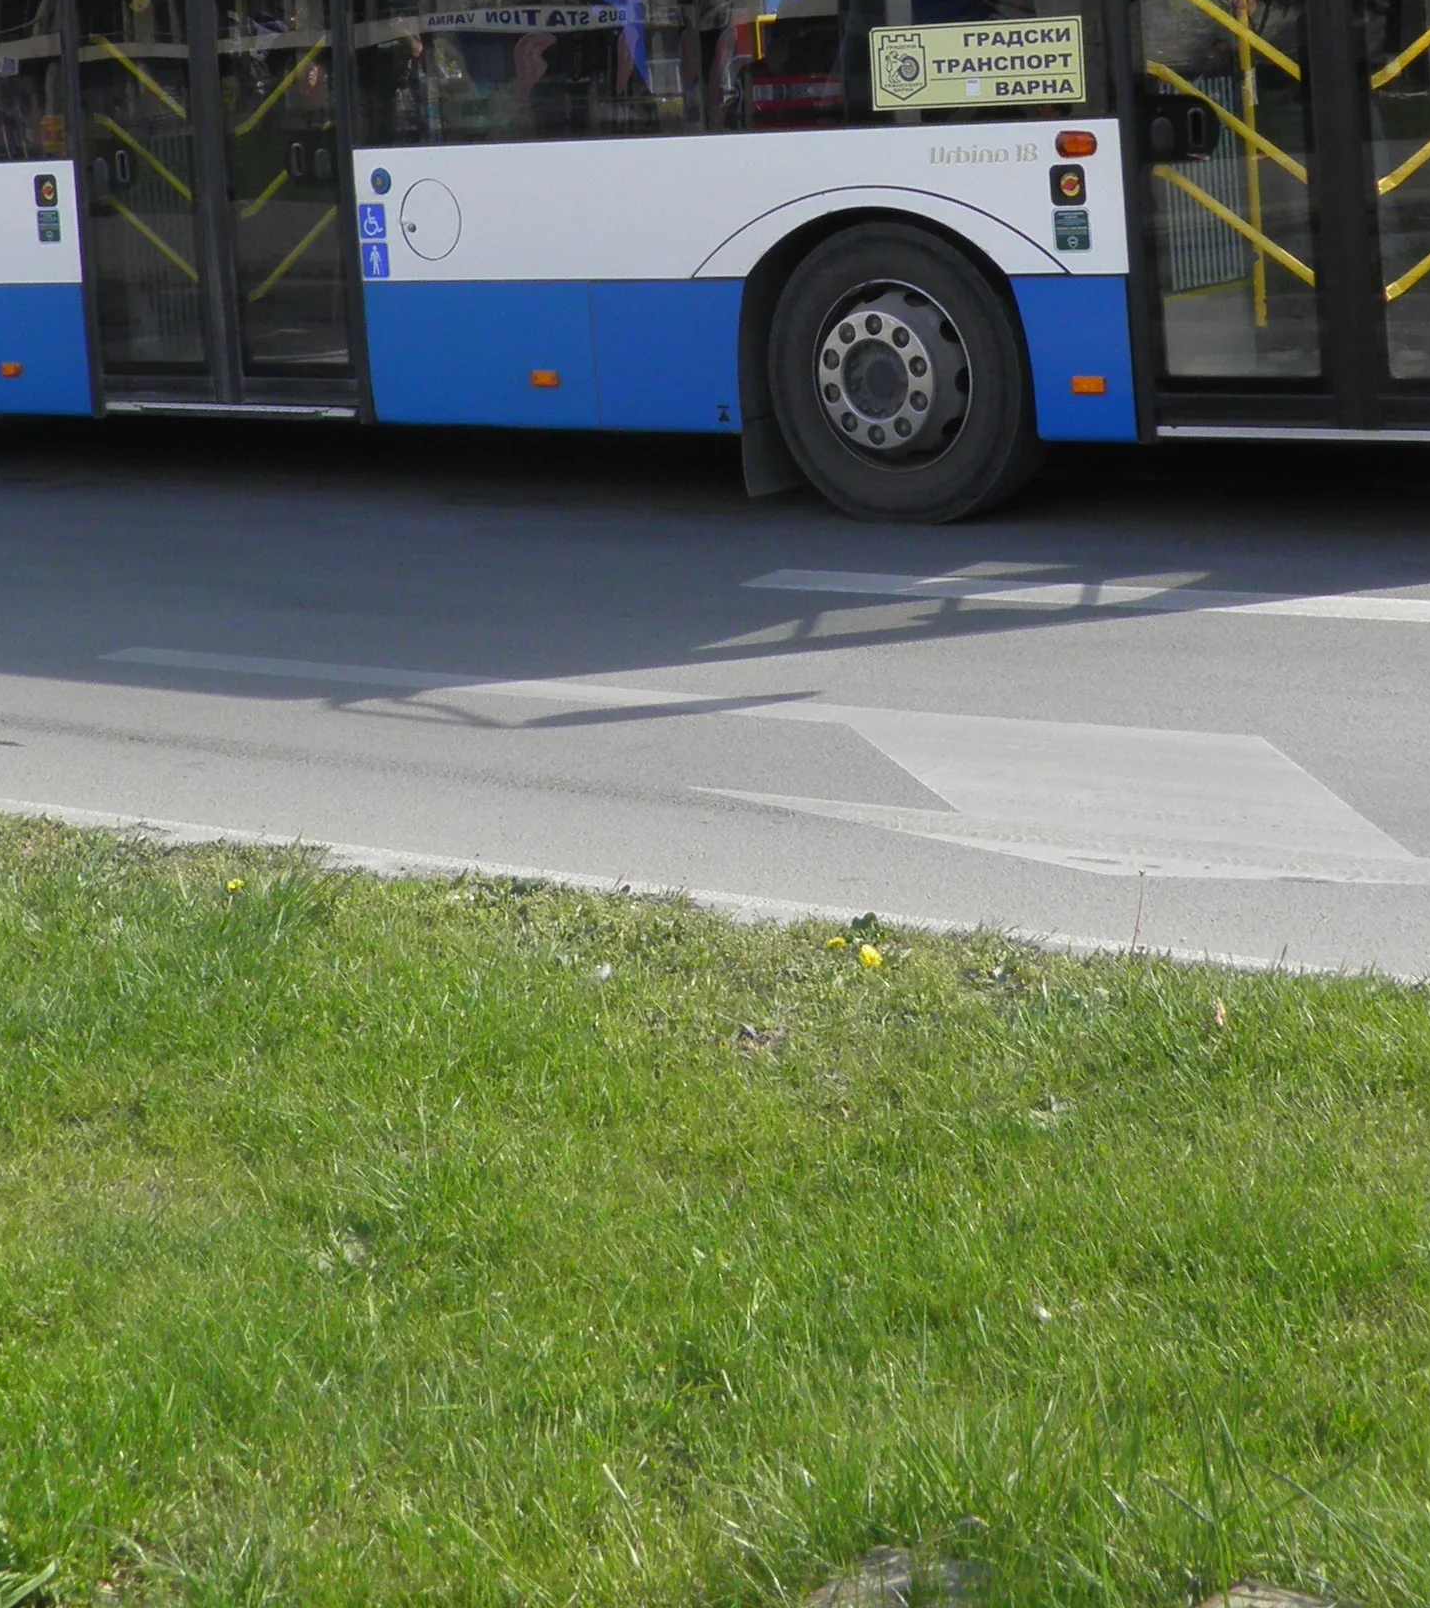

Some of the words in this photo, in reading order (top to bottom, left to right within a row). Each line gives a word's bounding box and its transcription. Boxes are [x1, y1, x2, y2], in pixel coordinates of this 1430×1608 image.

[963, 27, 1071, 48] ГРАДСКИ
[932, 53, 1072, 74] ТРАНСПОРТ
[995, 79, 1074, 96] ВАРНА
[930, 144, 1009, 165] Urbino
[1015, 143, 1038, 162] 18
